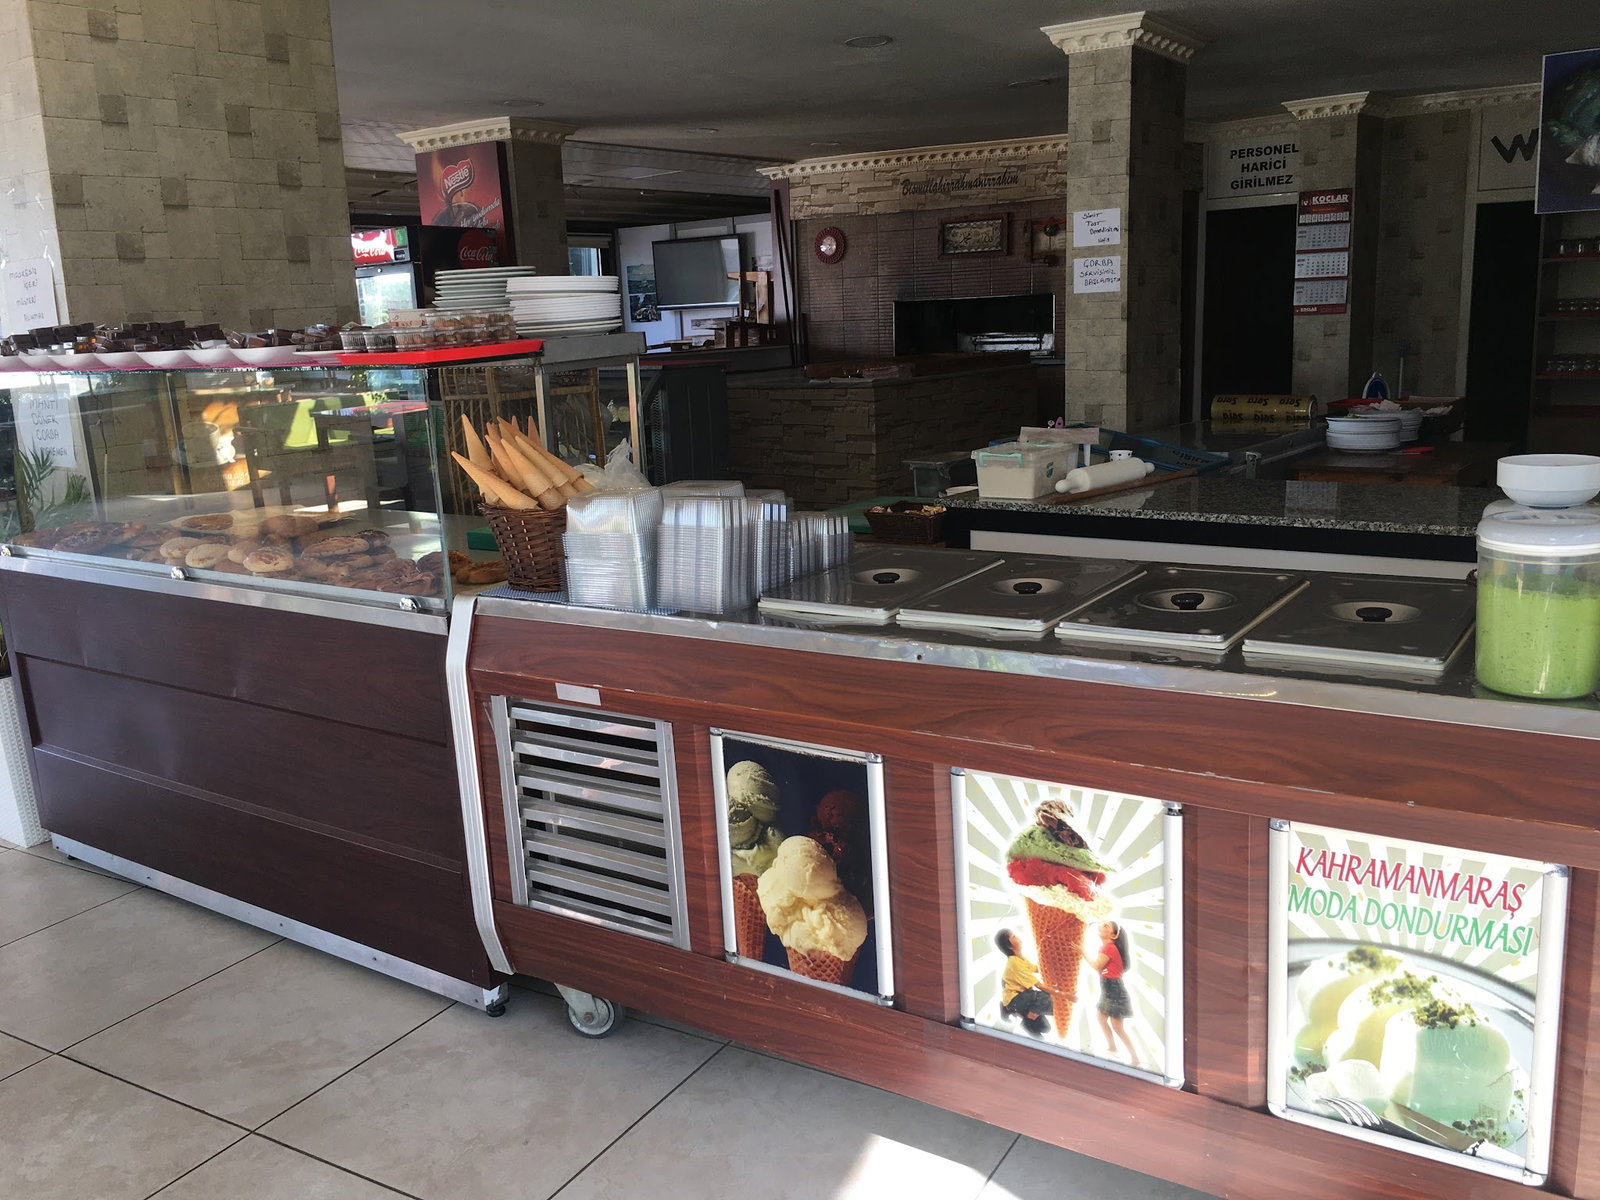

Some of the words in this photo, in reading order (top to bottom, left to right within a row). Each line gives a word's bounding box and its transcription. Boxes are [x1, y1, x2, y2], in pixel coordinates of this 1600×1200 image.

[1230, 143, 1299, 159] PERSONEL
[1241, 156, 1287, 173] HARİCİ
[443, 165, 470, 189] Nestlé
[1230, 174, 1294, 190] GİRİLMEZ
[460, 246, 493, 261] Coca-Cola
[1083, 259, 1114, 269] ÇORBA
[1295, 846, 1526, 920] KAHRAMANMARAŞ
[1287, 884, 1360, 924] MODA
[1363, 895, 1536, 957] DONDURMASI
